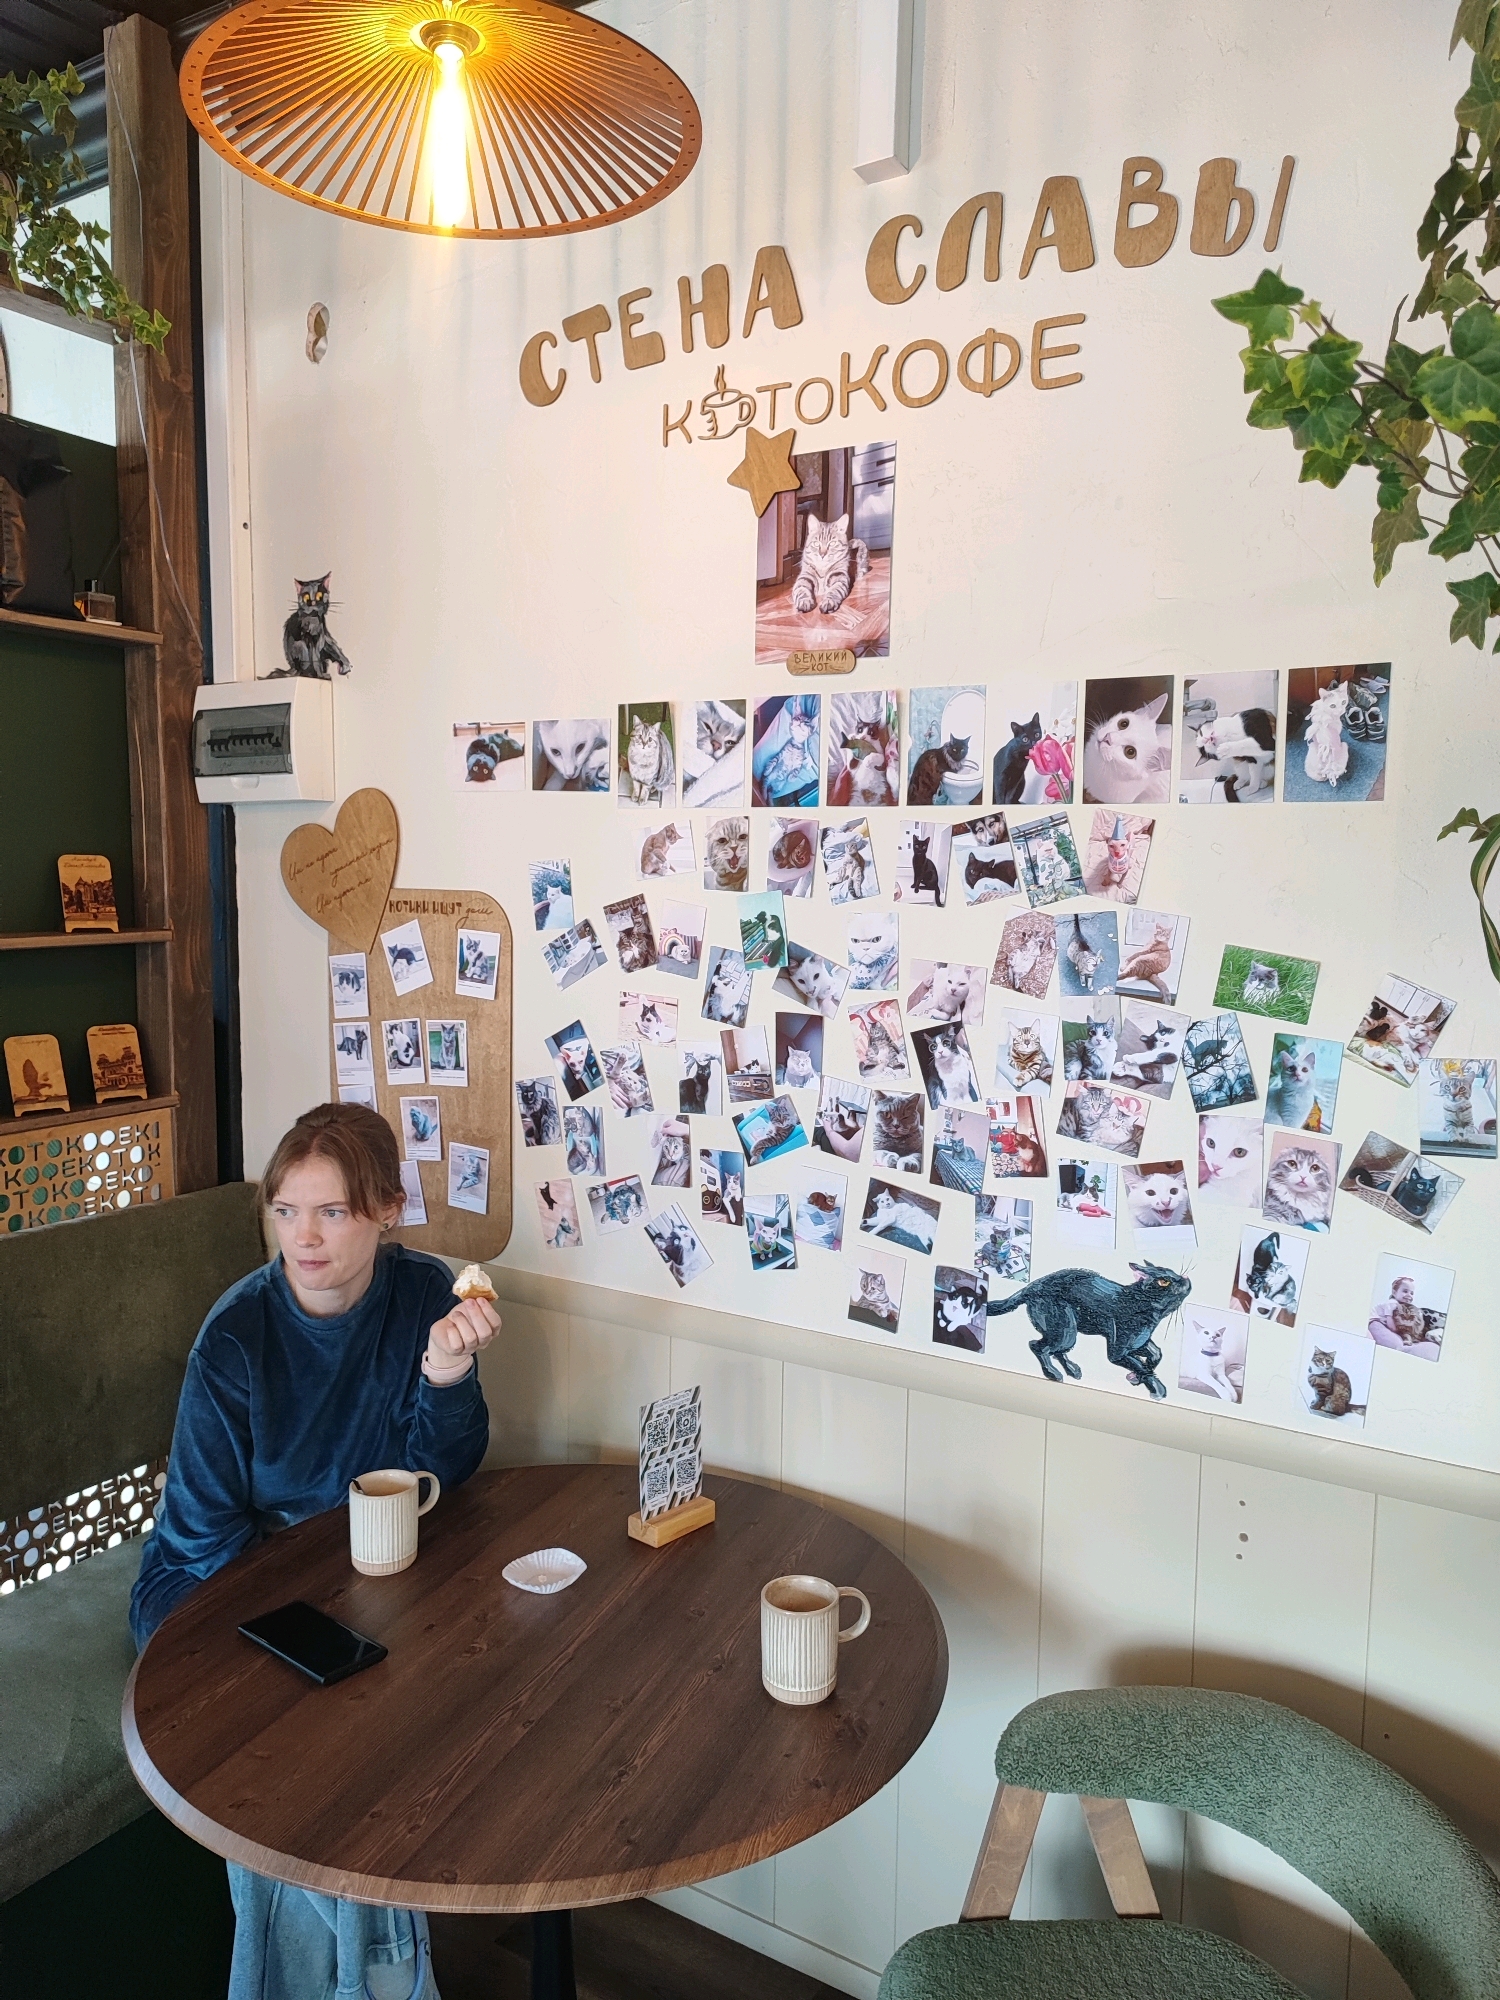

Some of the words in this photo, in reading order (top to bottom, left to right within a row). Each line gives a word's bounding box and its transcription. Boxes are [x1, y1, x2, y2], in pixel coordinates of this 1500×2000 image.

[517, 244, 803, 407] СТЕНА
[865, 155, 1296, 305] СЛАВЫ
[794, 650, 847, 664] ВЕЛИКИЙ
[811, 662, 829, 672] КОТ
[388, 899, 429, 915] КОТИКИ
[432, 900, 462, 917] ИЩУТ
